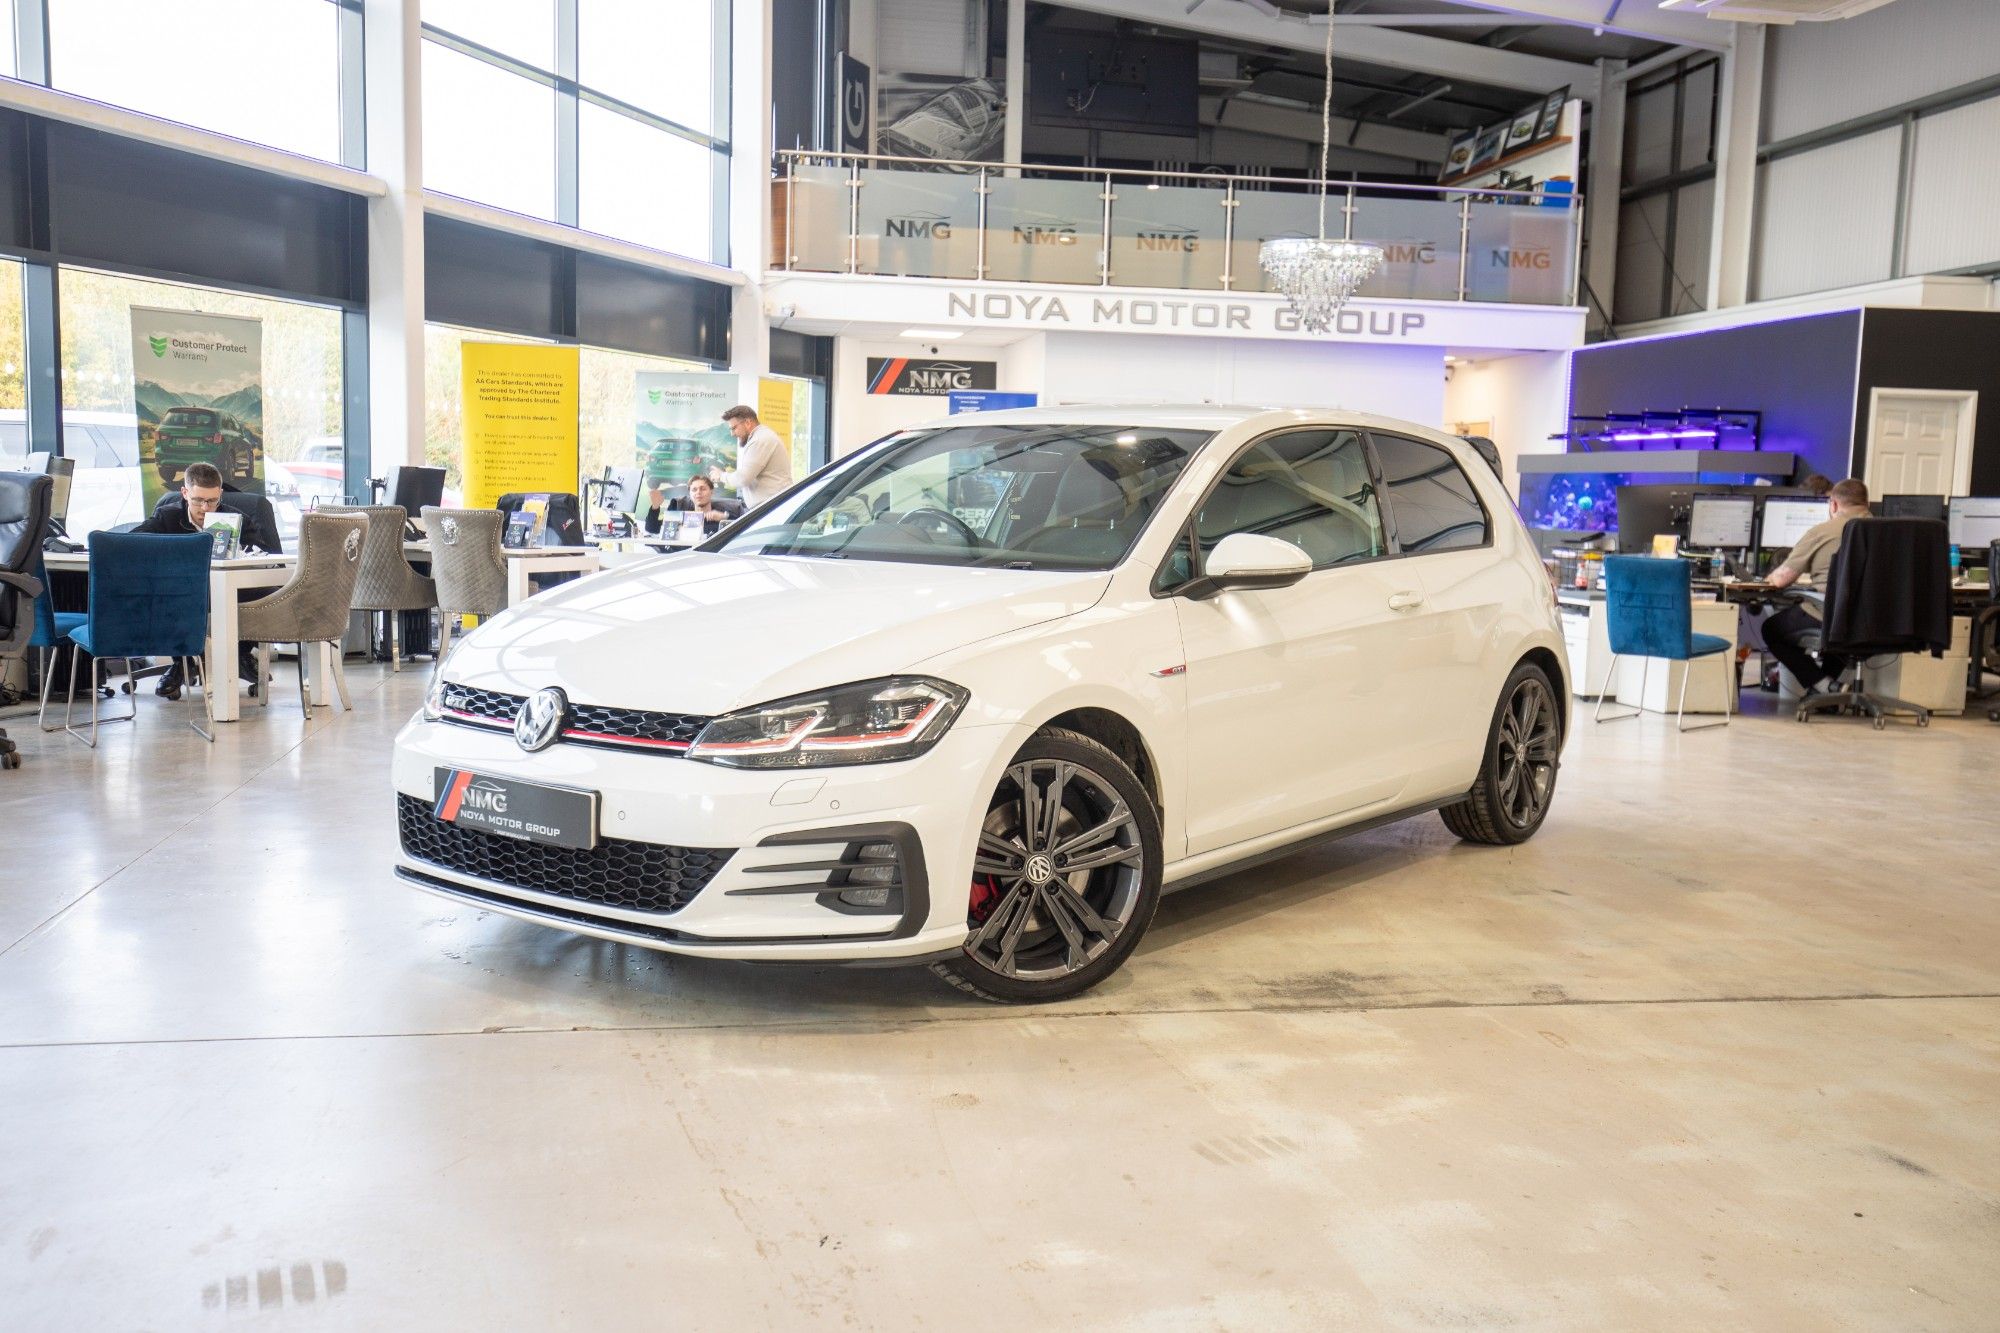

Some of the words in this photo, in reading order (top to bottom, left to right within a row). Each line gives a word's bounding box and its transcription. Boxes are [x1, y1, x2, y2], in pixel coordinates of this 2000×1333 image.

[886, 219, 951, 240] NMG
[1013, 225, 1077, 246] NMG
[1136, 232, 1199, 252] NMG
[1491, 249, 1550, 270] NMG
[948, 292, 1070, 321] NOYA
[1093, 298, 1251, 329] MOTOR
[172, 338, 214, 350] Customer
[216, 343, 247, 353] Protect
[172, 351, 208, 362] Warranty
[501, 379, 534, 387] Standards,
[909, 370, 972, 389] NMG
[480, 387, 507, 395] approved
[700, 391, 726, 399] Protect
[461, 786, 507, 813] NMG
[460, 809, 485, 822] NOYA
[488, 815, 523, 830] MOTOR
[525, 823, 561, 838] GROUP
